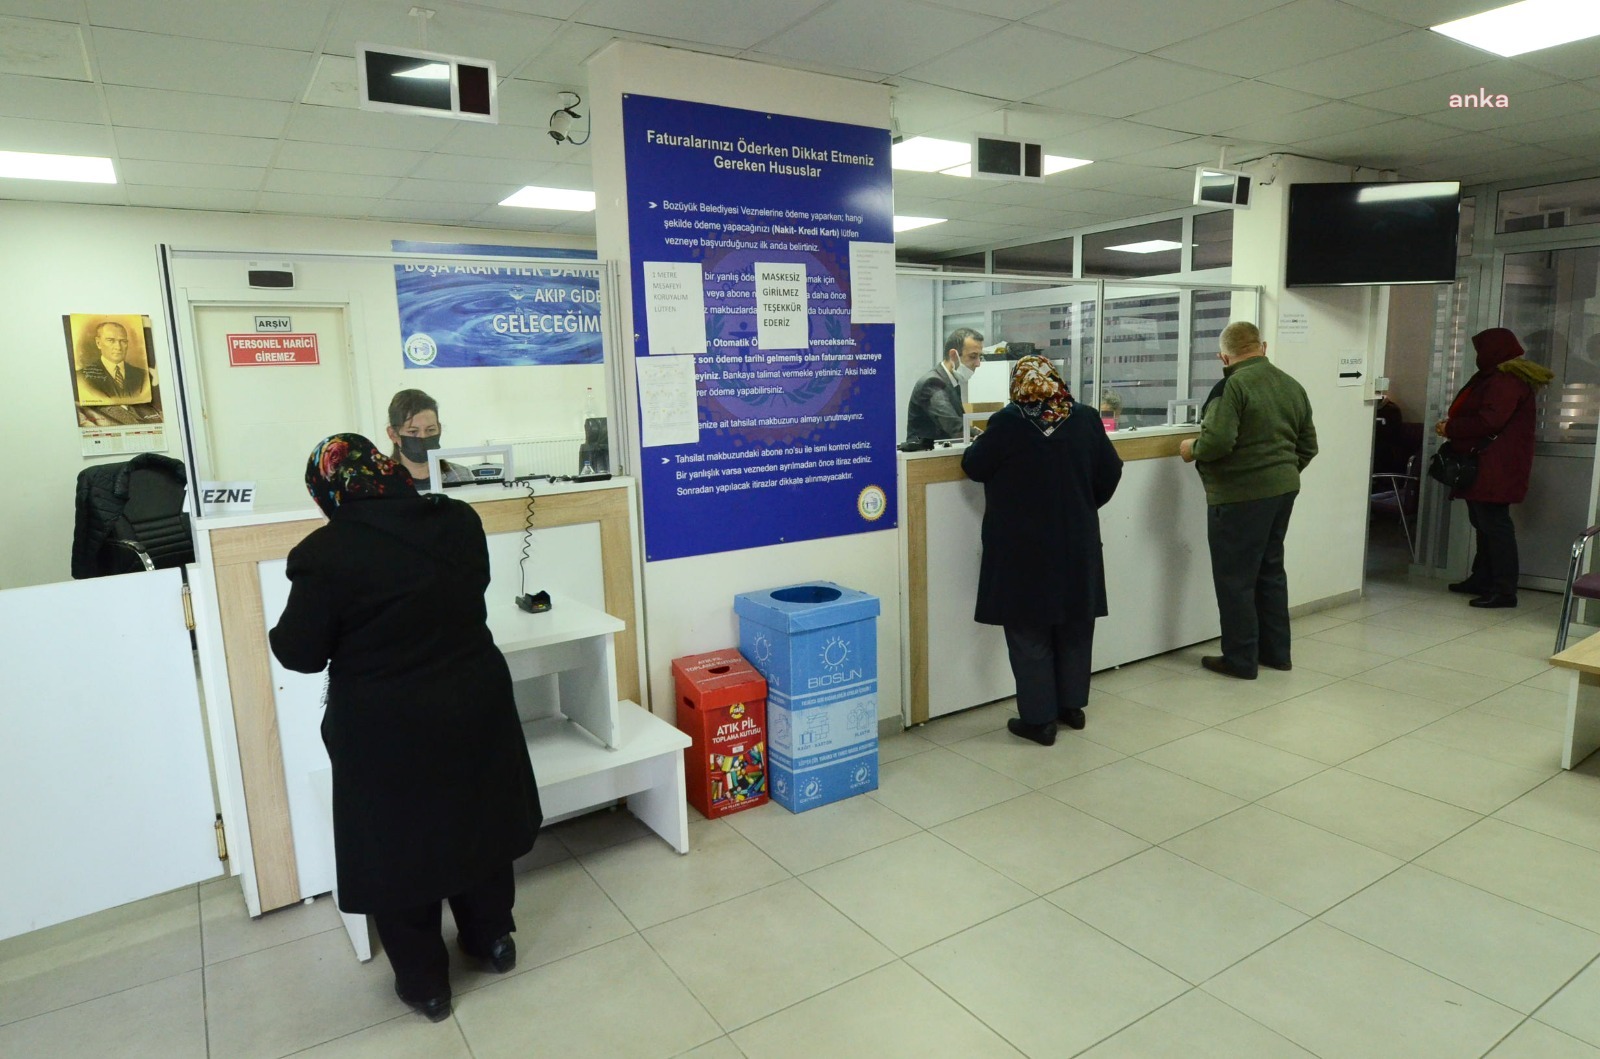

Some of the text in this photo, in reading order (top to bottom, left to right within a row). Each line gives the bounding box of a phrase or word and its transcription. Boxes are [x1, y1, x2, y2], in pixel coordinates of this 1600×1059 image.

[647, 129, 875, 166] Faturalarınızı Öderken Dikkat Etmeniz
[713, 155, 822, 177] Gereken Hususlar
[663, 200, 698, 213] Bozüyük
[699, 202, 739, 216] Belediyesi
[740, 205, 784, 218] Veznelerine
[785, 209, 810, 219] ödeme
[845, 213, 864, 225] hangi
[663, 218, 693, 230] şekilde
[693, 220, 721, 231] ödeme
[722, 223, 770, 234] yapacağınızı
[798, 226, 818, 236] Kredi
[840, 228, 860, 238] lütfen
[664, 236, 699, 248] vezneye
[700, 237, 759, 250] başvurduğunuz
[760, 240, 768, 249] ilk
[770, 241, 788, 251] anda
[657, 271, 678, 279] METRE
[704, 271, 836, 286] bir yanlış öde mak için
[761, 271, 801, 282] MASKESİZ
[534, 288, 566, 303] AKIP
[706, 289, 725, 300] veya
[726, 288, 751, 299] abone
[811, 290, 829, 299] daha
[830, 290, 847, 300] önce
[762, 286, 800, 297] GİRİLMEZ
[763, 301, 802, 313] TEŞEKKÜR
[817, 306, 851, 316] bulunduru
[258, 319, 289, 329] ARŞİV
[763, 317, 790, 327] EDERİZ
[232, 336, 314, 349] PERSONEL HARİCİ
[713, 338, 750, 347] Otomatik
[809, 337, 857, 347] verecekseniz,
[255, 350, 296, 362] GİREMEZ
[698, 355, 714, 364] son
[715, 353, 743, 364] ödeme
[744, 354, 765, 363] tarihi
[766, 353, 803, 364] gelmemiş
[804, 353, 820, 362] olan
[821, 352, 854, 361] faturanızı
[855, 353, 882, 362] vezneye
[695, 371, 721, 382] eyiniz.
[722, 370, 756, 380] Bankaya
[756, 369, 781, 378] talimat
[781, 368, 814, 378] vermekle
[844, 367, 859, 376] Aksi
[859, 366, 877, 376] halde
[708, 387, 736, 397] ödeme
[736, 384, 785, 397] yapabilirsiniz.
[698, 420, 718, 430] enize
[719, 419, 730, 428] ait
[730, 417, 757, 428] tahsilat
[758, 415, 799, 426] makbuzunu
[800, 414, 823, 425] almayı
[675, 453, 705, 464] Tahsilat
[706, 449, 760, 461] makbuzundaki
[760, 447, 784, 457] abone
[804, 445, 813, 454] ile
[813, 443, 828, 452] ismi
[828, 441, 851, 452] kontrol
[676, 470, 687, 480] Bir
[688, 468, 721, 481] yanlışlık
[721, 466, 742, 476] varsa
[743, 463, 778, 474] vezneden
[779, 460, 817, 472] ayrılmadan
[818, 459, 835, 468] önce
[835, 457, 852, 466] itiraz
[676, 485, 715, 496] Sonradan
[715, 481, 751, 495] yapılacak
[751, 479, 778, 489] itirazlar
[778, 476, 804, 487] dikkate
[201, 488, 253, 504] EZNE
[807, 668, 863, 689] BIOSUN
[716, 716, 757, 736] ATIK PİL
[712, 727, 762, 744] TOPLAMA KUTUSU
